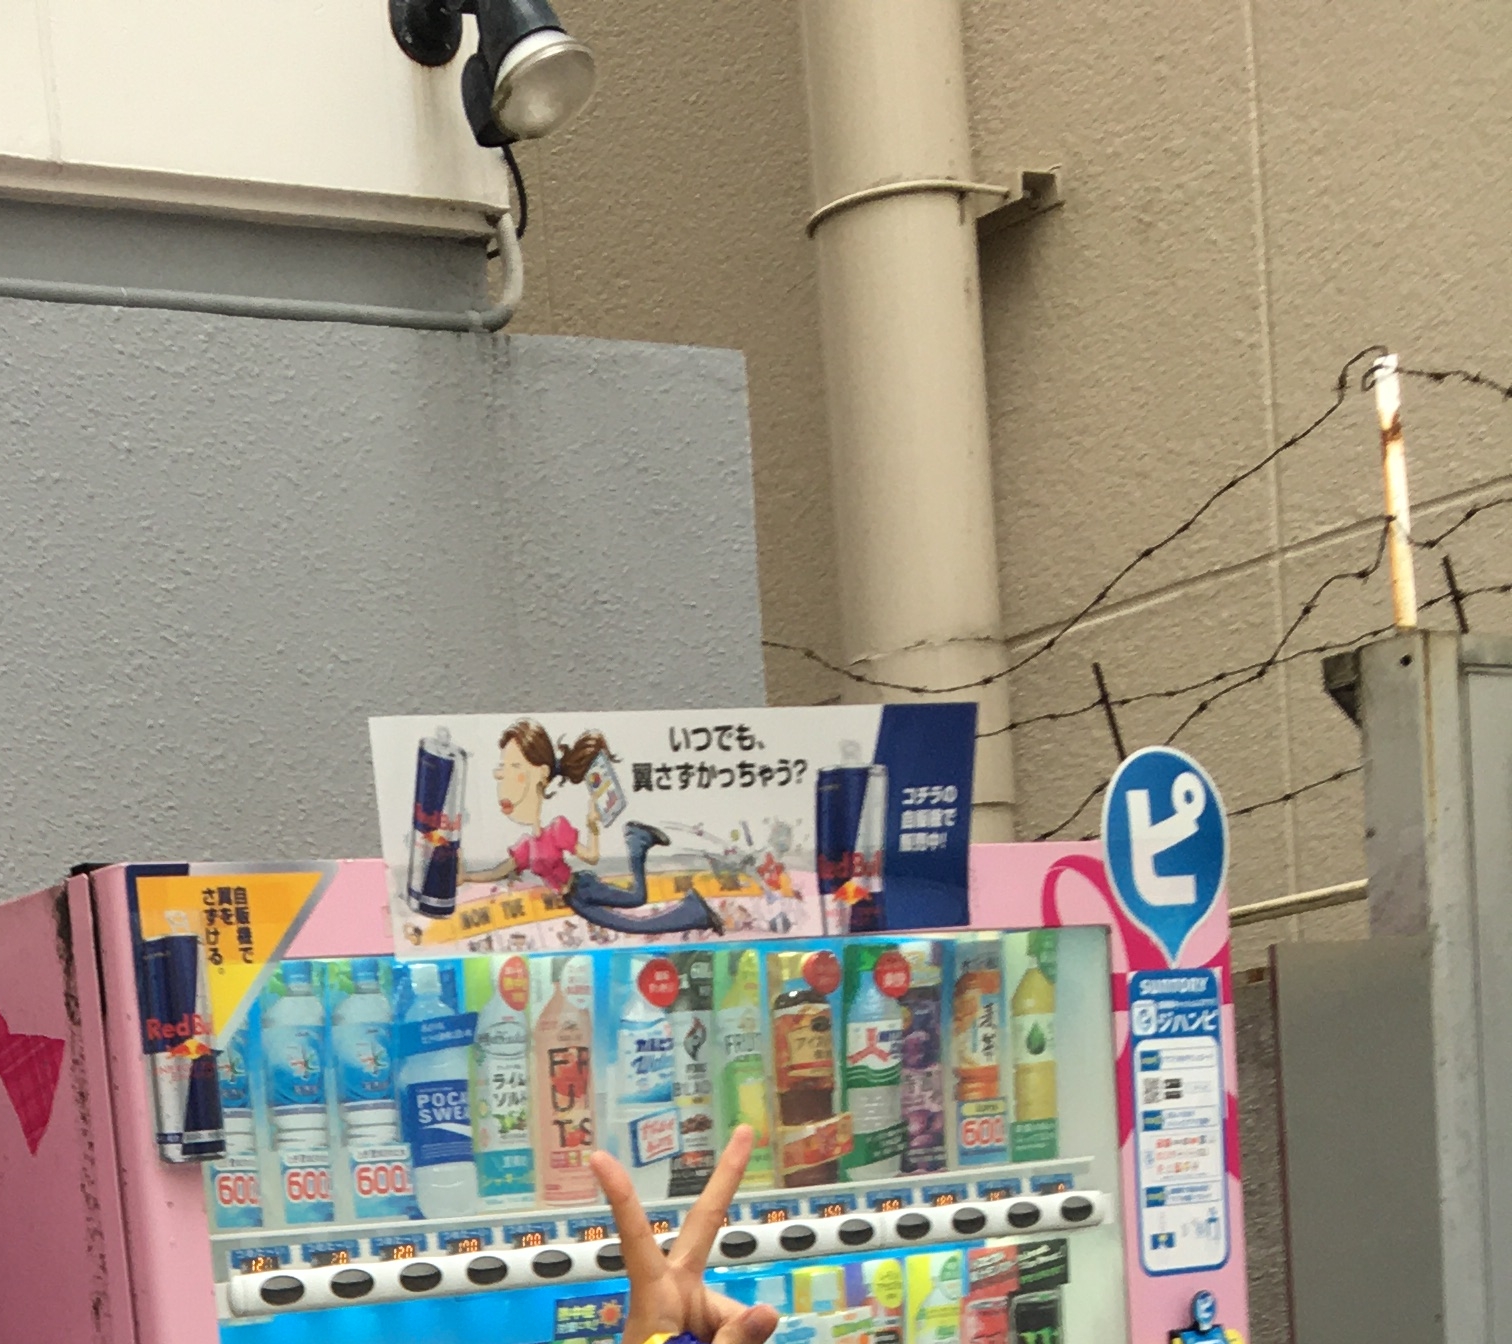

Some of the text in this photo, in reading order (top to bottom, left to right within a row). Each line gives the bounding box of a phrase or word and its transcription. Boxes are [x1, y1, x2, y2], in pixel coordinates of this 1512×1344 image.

[668, 725, 768, 755] いつでも、
[1124, 770, 1209, 907] ピ
